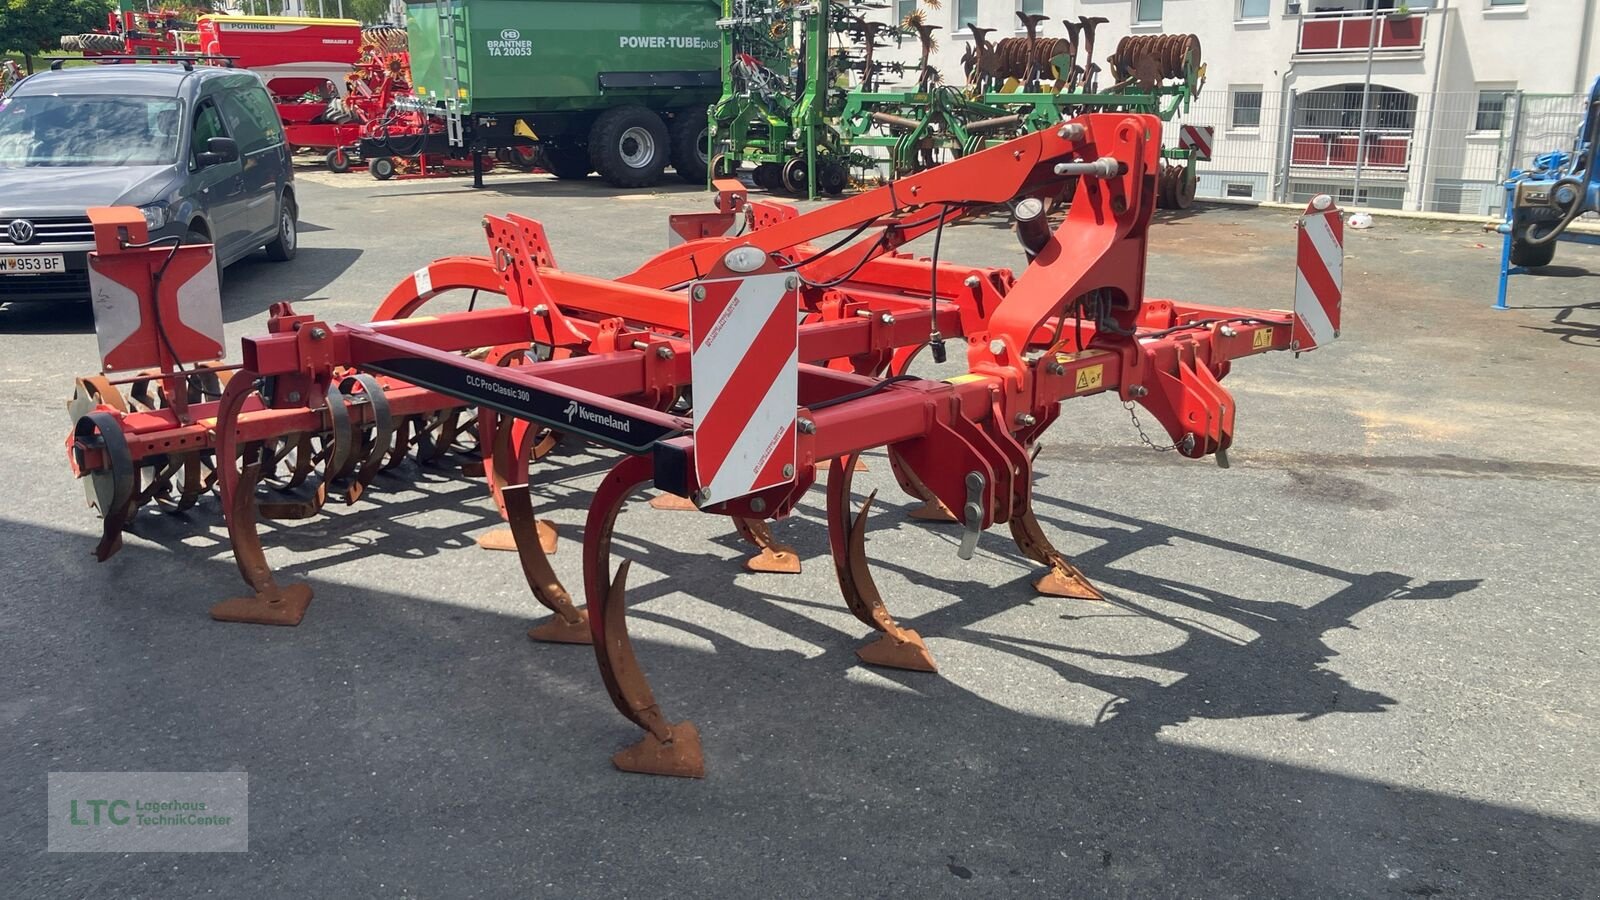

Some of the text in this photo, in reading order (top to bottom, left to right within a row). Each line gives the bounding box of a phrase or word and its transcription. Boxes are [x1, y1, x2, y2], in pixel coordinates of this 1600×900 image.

[487, 40, 532, 48] BRANTNER
[489, 47, 532, 57] TA 20053
[17, 257, 41, 270] 953
[43, 257, 59, 270] BF
[466, 374, 530, 402] CLC Pro Classic 300
[578, 406, 630, 433] Kverneland
